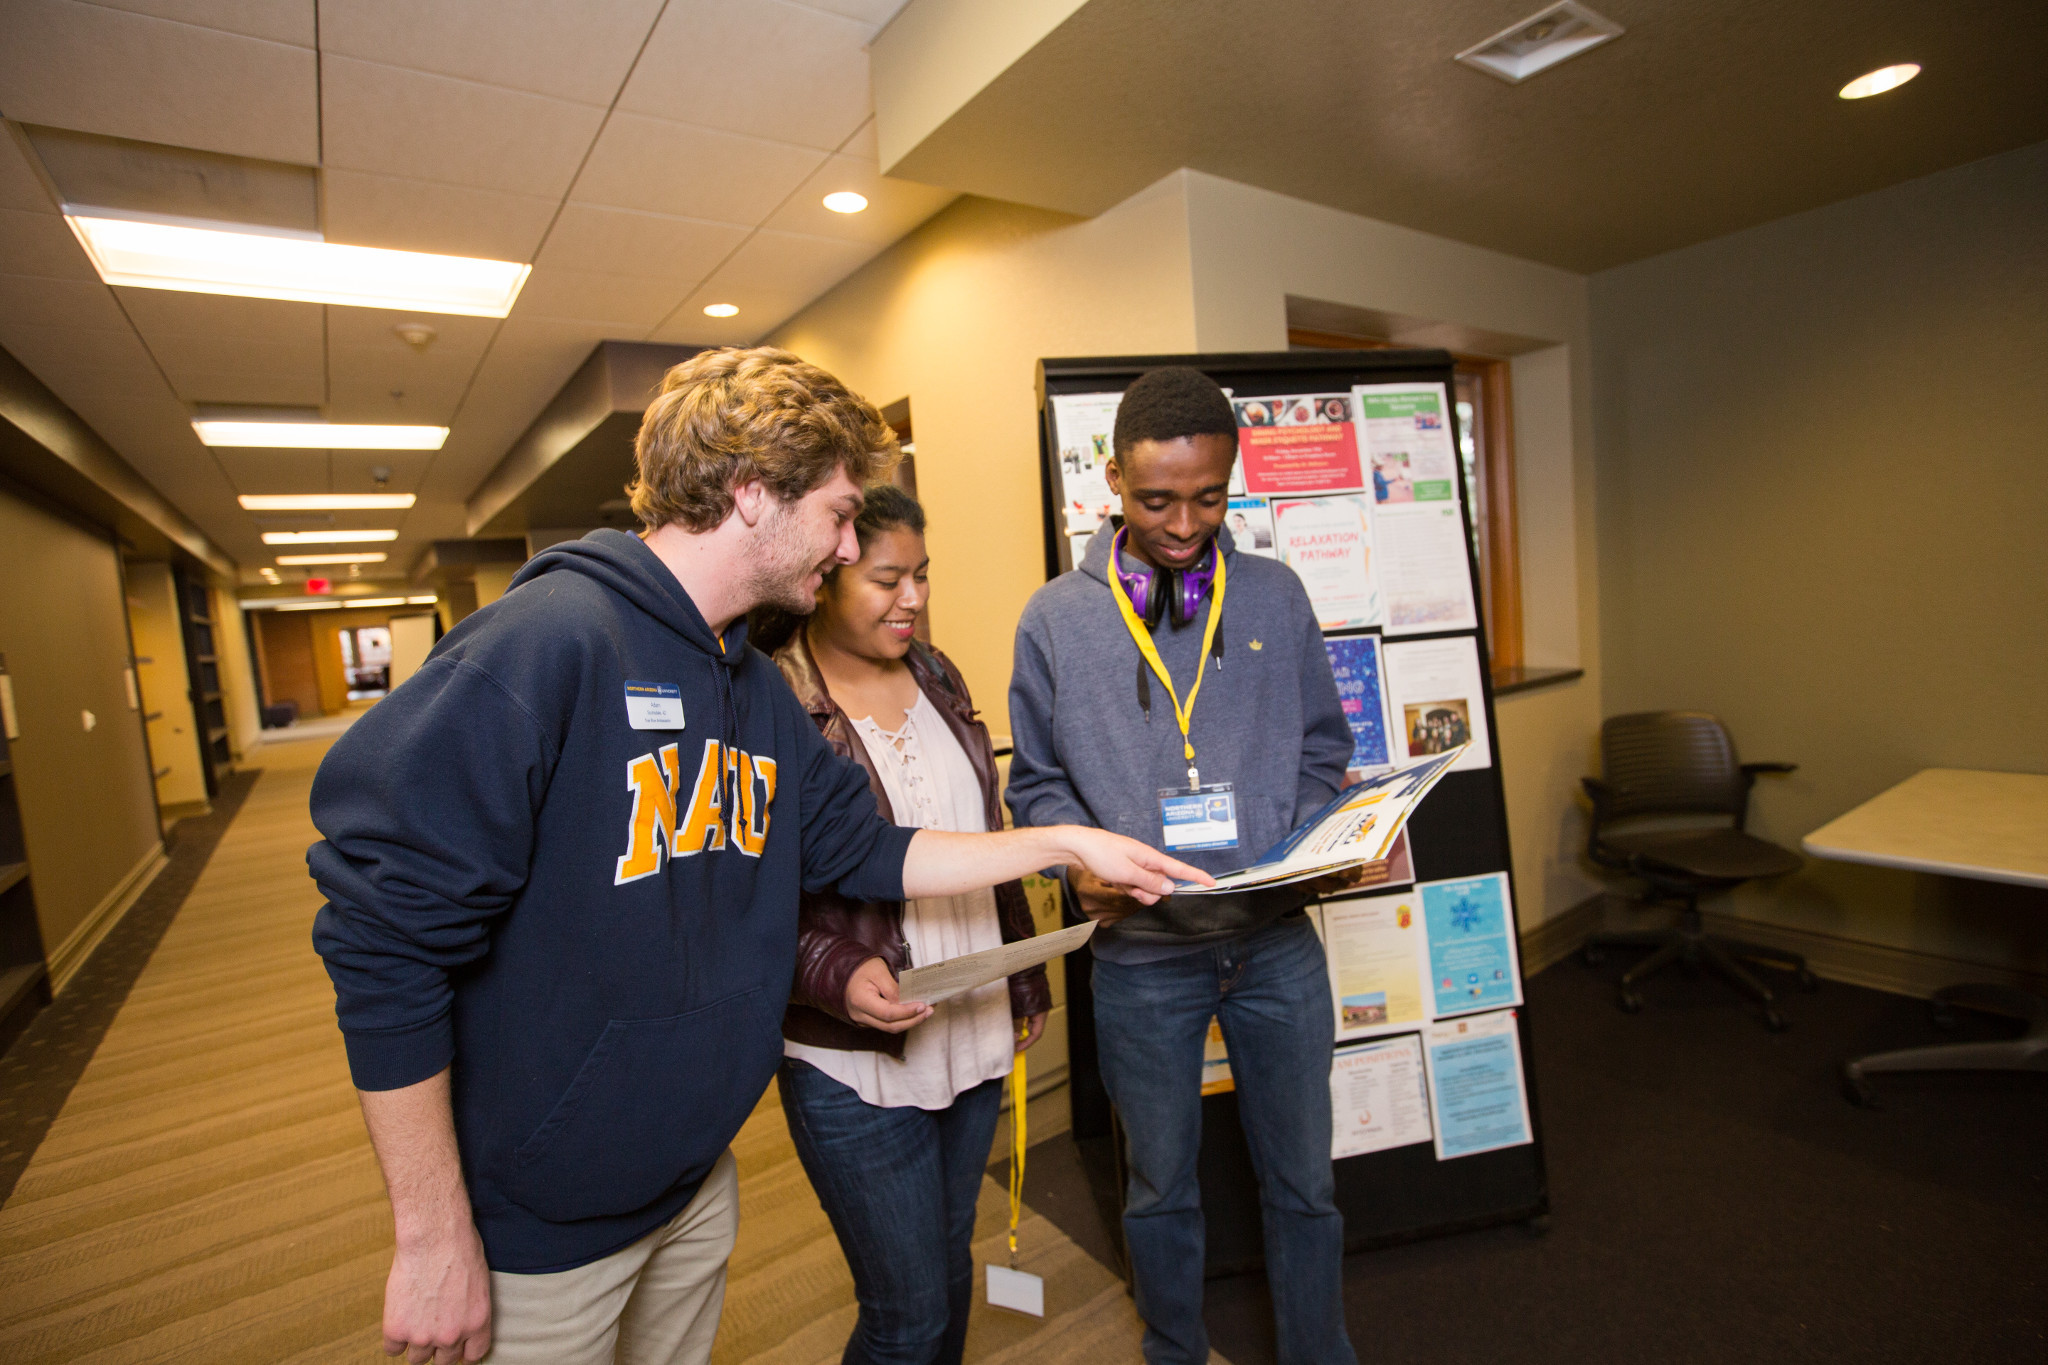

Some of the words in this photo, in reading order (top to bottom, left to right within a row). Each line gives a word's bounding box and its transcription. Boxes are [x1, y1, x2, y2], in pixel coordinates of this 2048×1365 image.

[1289, 531, 1359, 548] RELAXATION
[1300, 547, 1352, 562] PATHWAY
[614, 739, 777, 886] NAU
[1165, 803, 1203, 812] NORTHERN
[1165, 809, 1195, 817] ARIZONA
